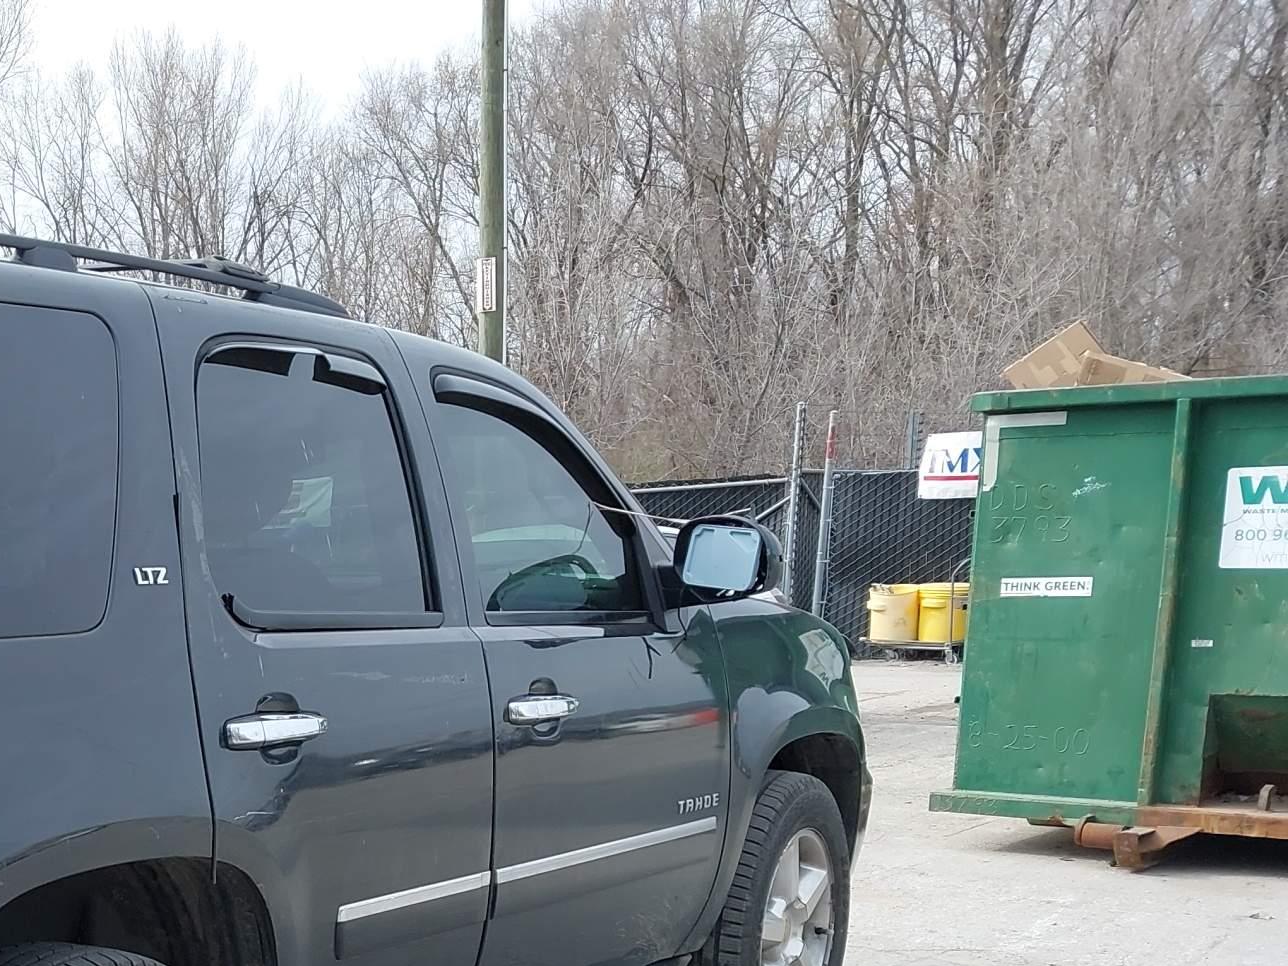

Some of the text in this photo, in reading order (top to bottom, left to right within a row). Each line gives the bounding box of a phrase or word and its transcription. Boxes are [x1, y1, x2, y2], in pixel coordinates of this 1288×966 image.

[991, 515, 1072, 544] 3793
[1234, 528, 1267, 541] 800
[134, 567, 169, 585] LTZ
[1003, 582, 1040, 592] THINK
[677, 793, 720, 815] TAHOE
